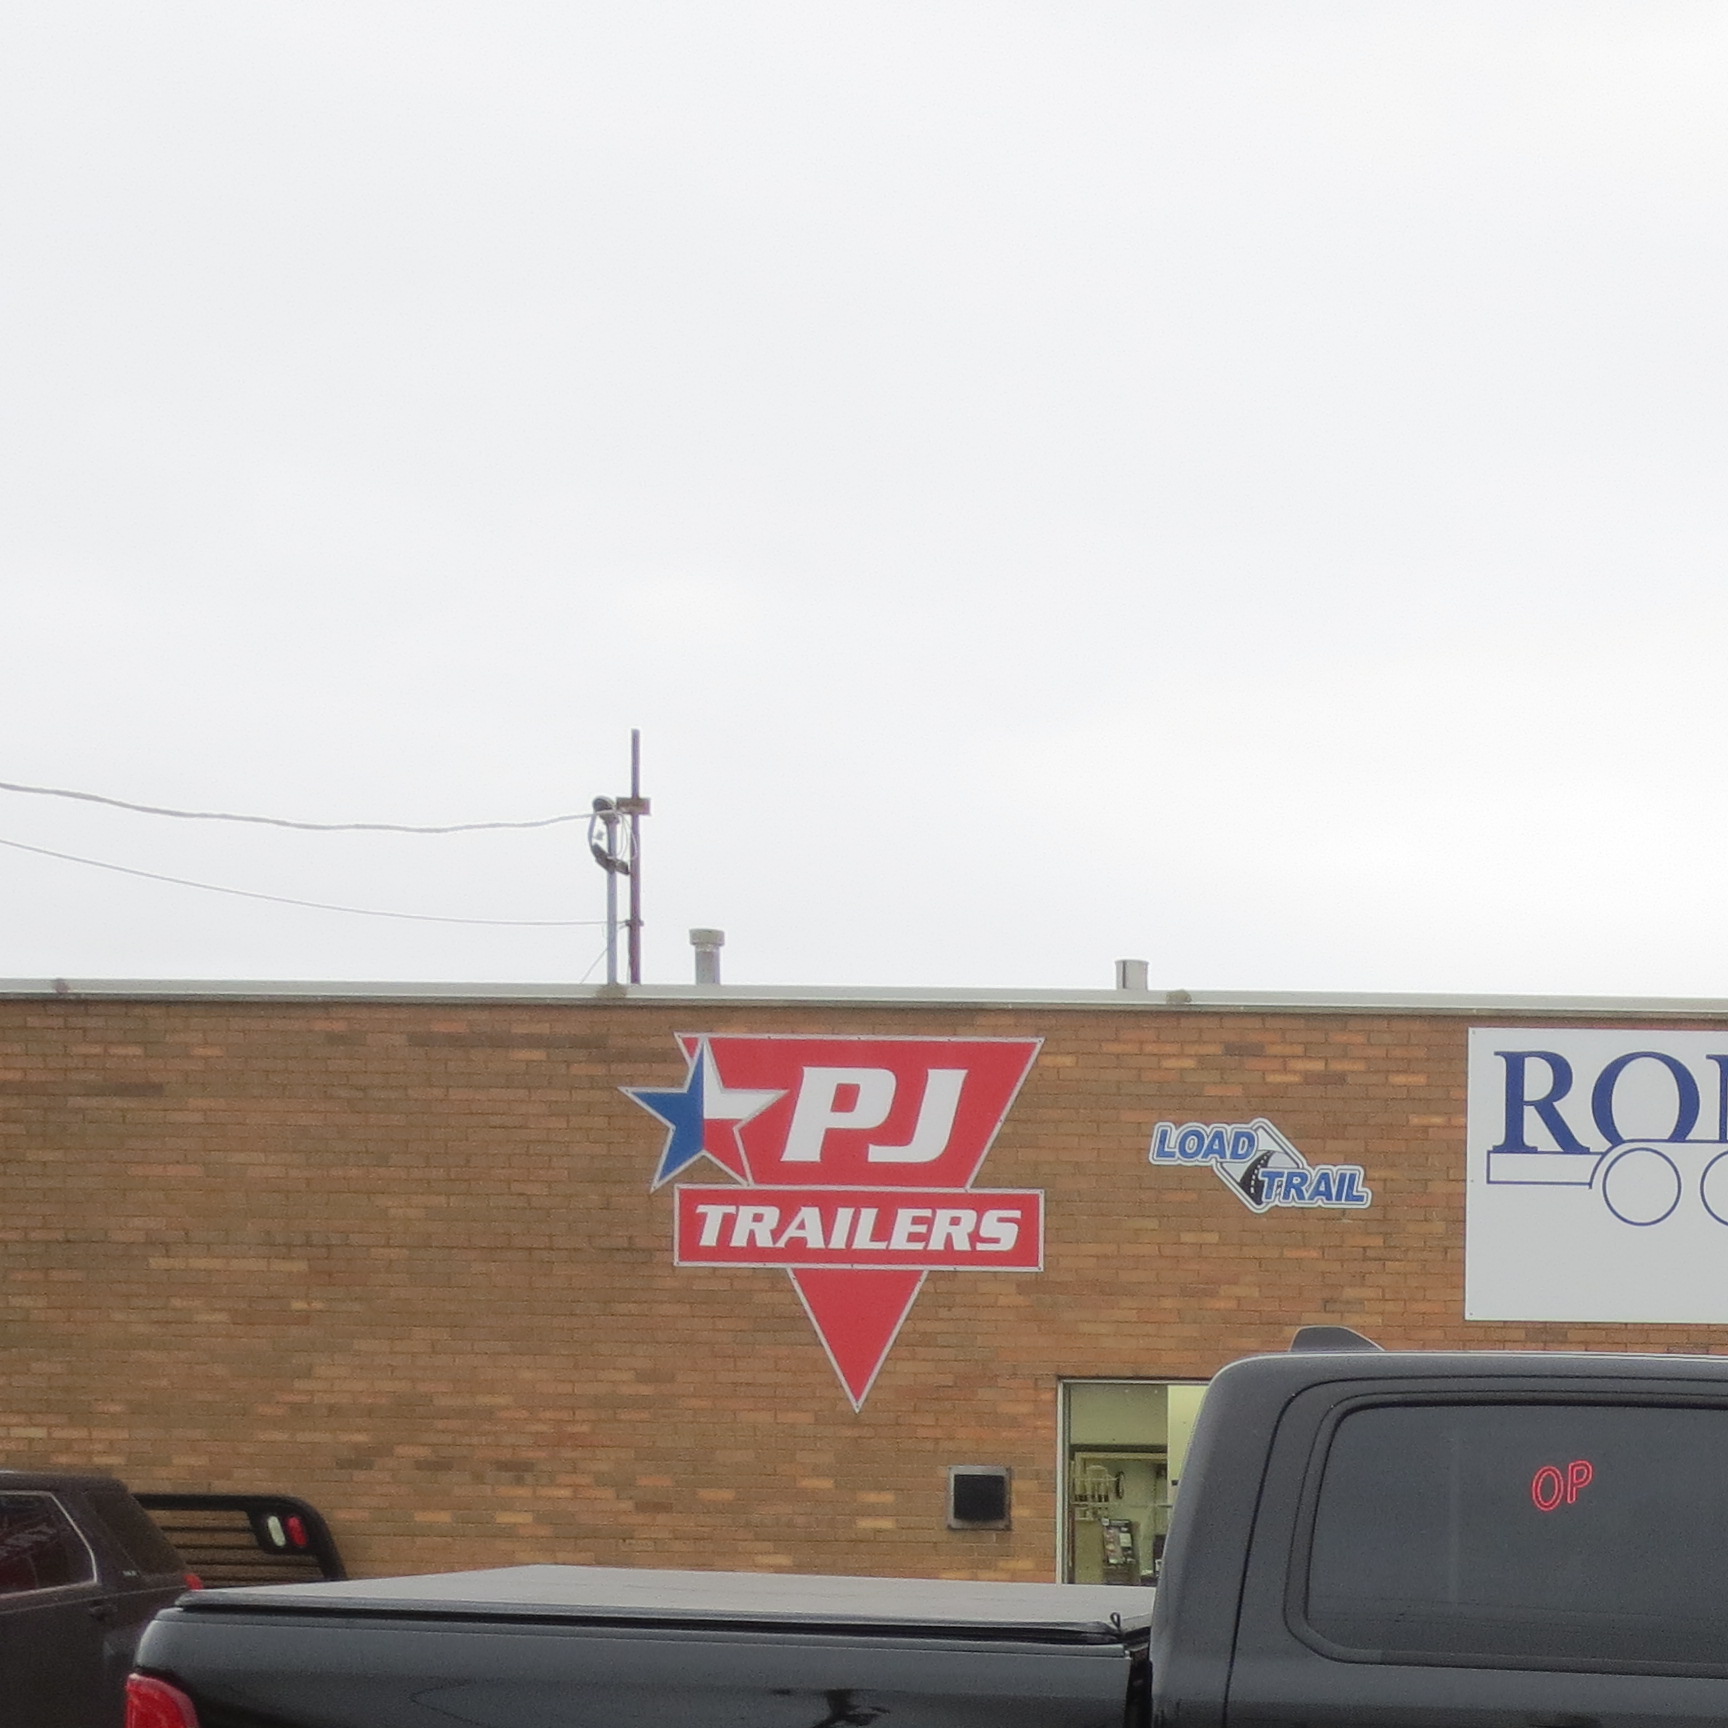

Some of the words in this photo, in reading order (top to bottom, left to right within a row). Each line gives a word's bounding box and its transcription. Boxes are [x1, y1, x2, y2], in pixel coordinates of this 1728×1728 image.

[781, 1065, 969, 1164] PJ
[1155, 1128, 1257, 1161] LOAD
[1259, 1170, 1366, 1203] TRAIL
[695, 1203, 1022, 1253] TRAILERS
[1531, 1459, 1594, 1512] OP
